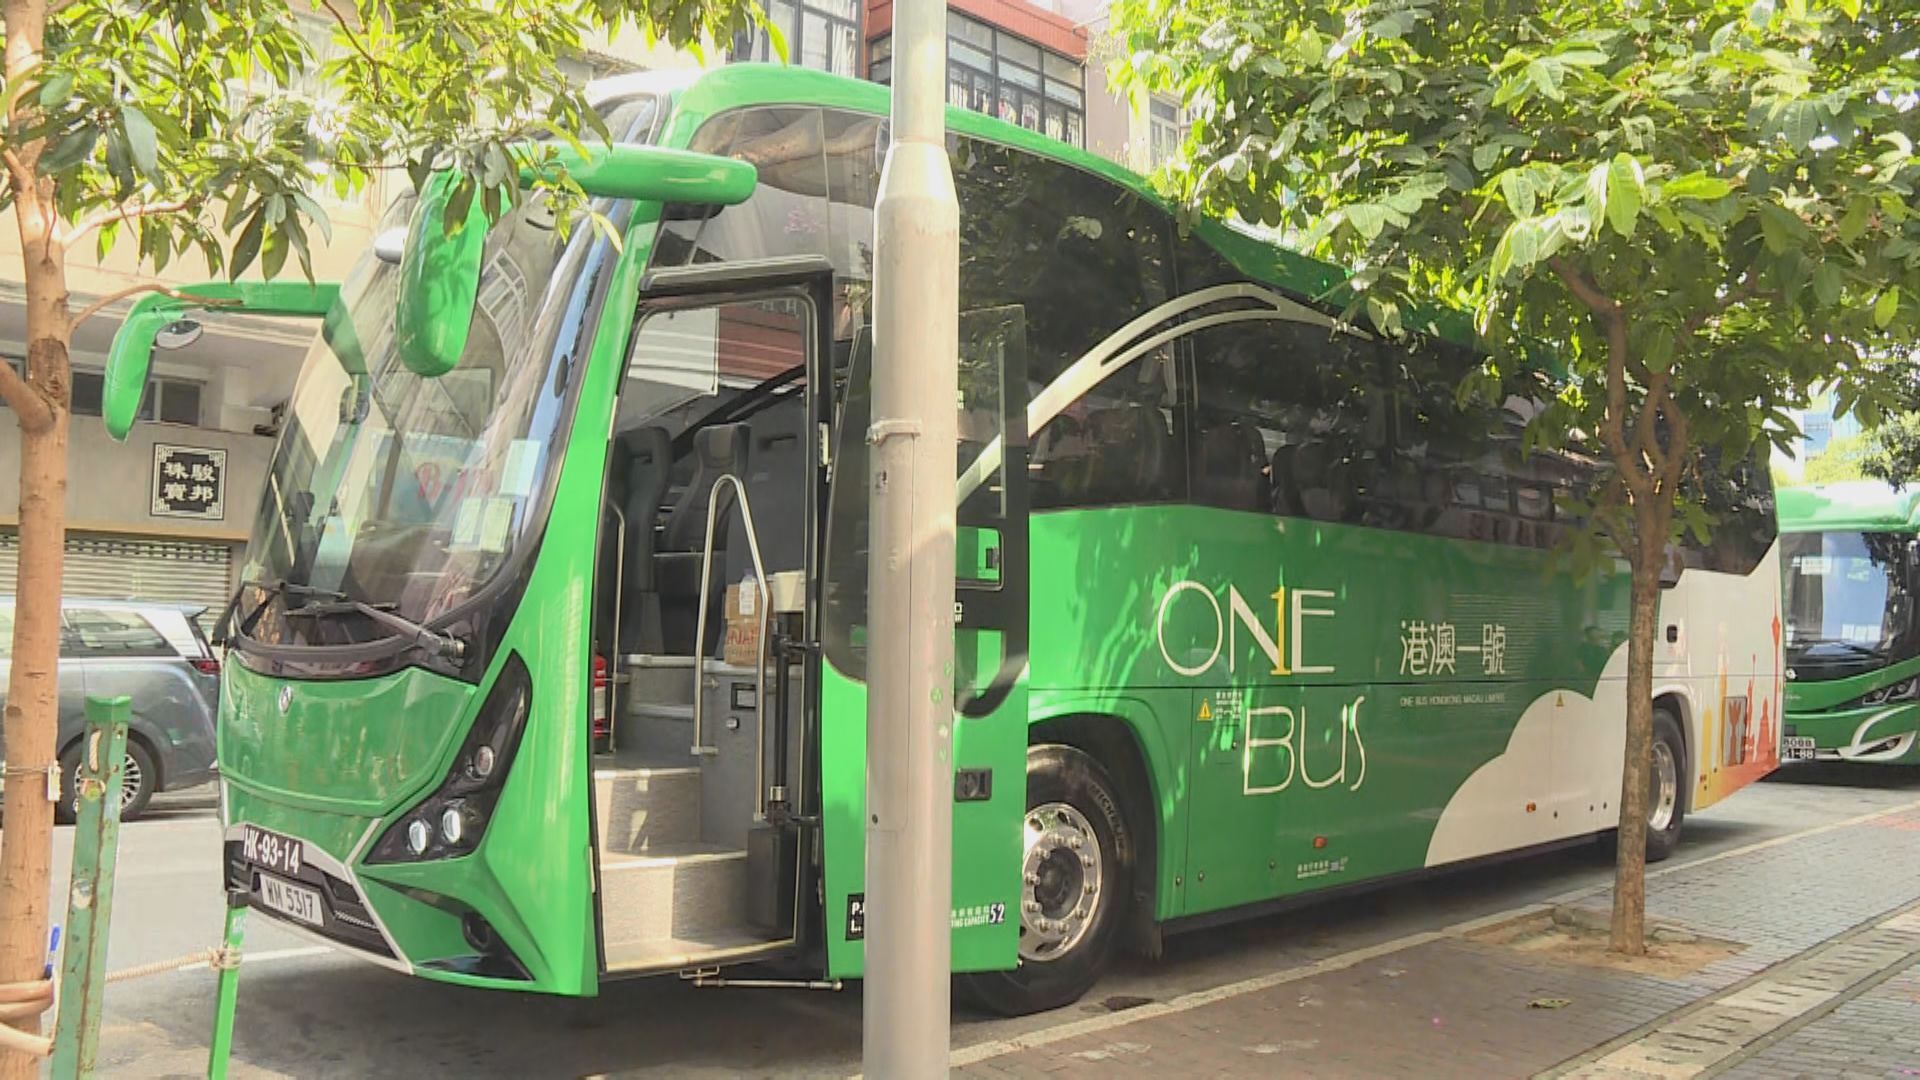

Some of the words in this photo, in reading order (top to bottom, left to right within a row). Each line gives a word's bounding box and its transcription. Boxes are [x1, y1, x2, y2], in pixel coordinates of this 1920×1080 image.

[1400, 620, 1506, 675] 港澳一號
[1243, 695, 1366, 795] BUS
[243, 827, 300, 874] HK-93-14
[265, 880, 283, 911] WM
[286, 886, 313, 919] 5317
[990, 903, 1005, 924] 52
